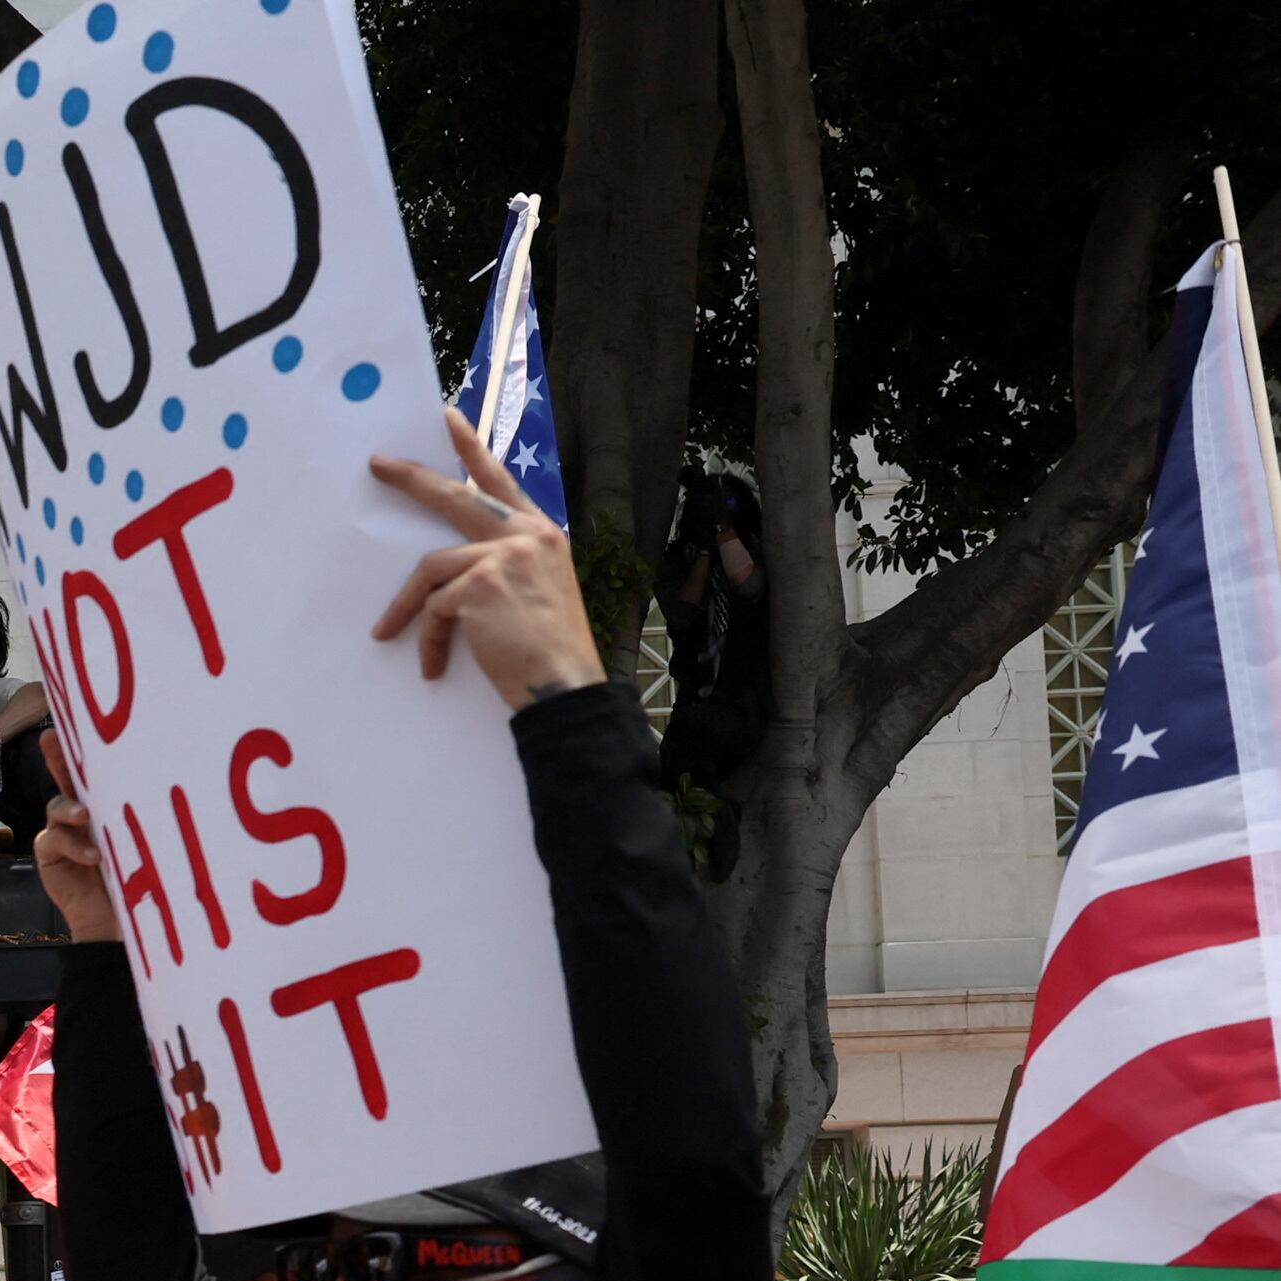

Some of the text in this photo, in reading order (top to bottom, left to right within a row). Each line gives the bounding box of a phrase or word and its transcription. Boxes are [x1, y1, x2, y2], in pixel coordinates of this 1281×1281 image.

[29, 466, 235, 791] NOT
[102, 727, 347, 982] HIS
[150, 946, 422, 1196] #IT
